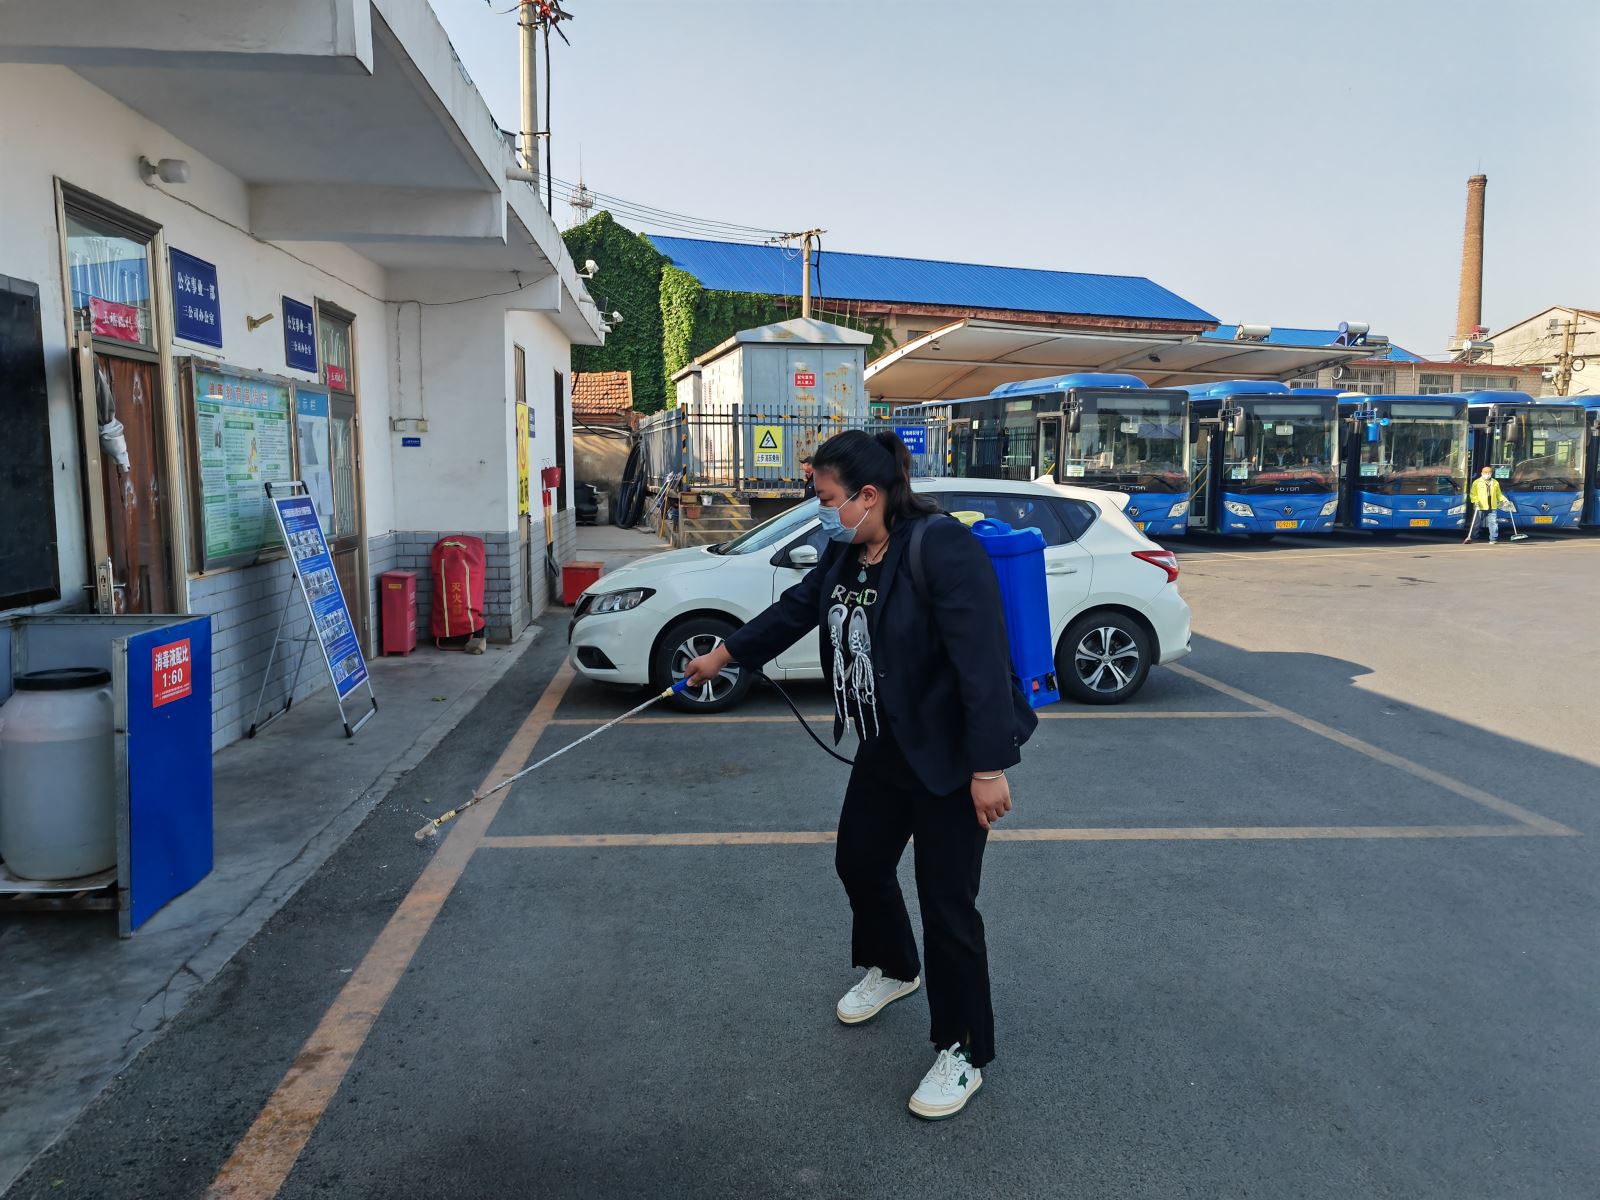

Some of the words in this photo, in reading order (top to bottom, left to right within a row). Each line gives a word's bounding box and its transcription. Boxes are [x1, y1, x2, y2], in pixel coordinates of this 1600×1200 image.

[177, 271, 216, 301] 公交事业一部
[183, 304, 215, 326] 三公司办公室
[155, 645, 188, 672] 消毒液配比
[162, 668, 183, 688] 1:60
